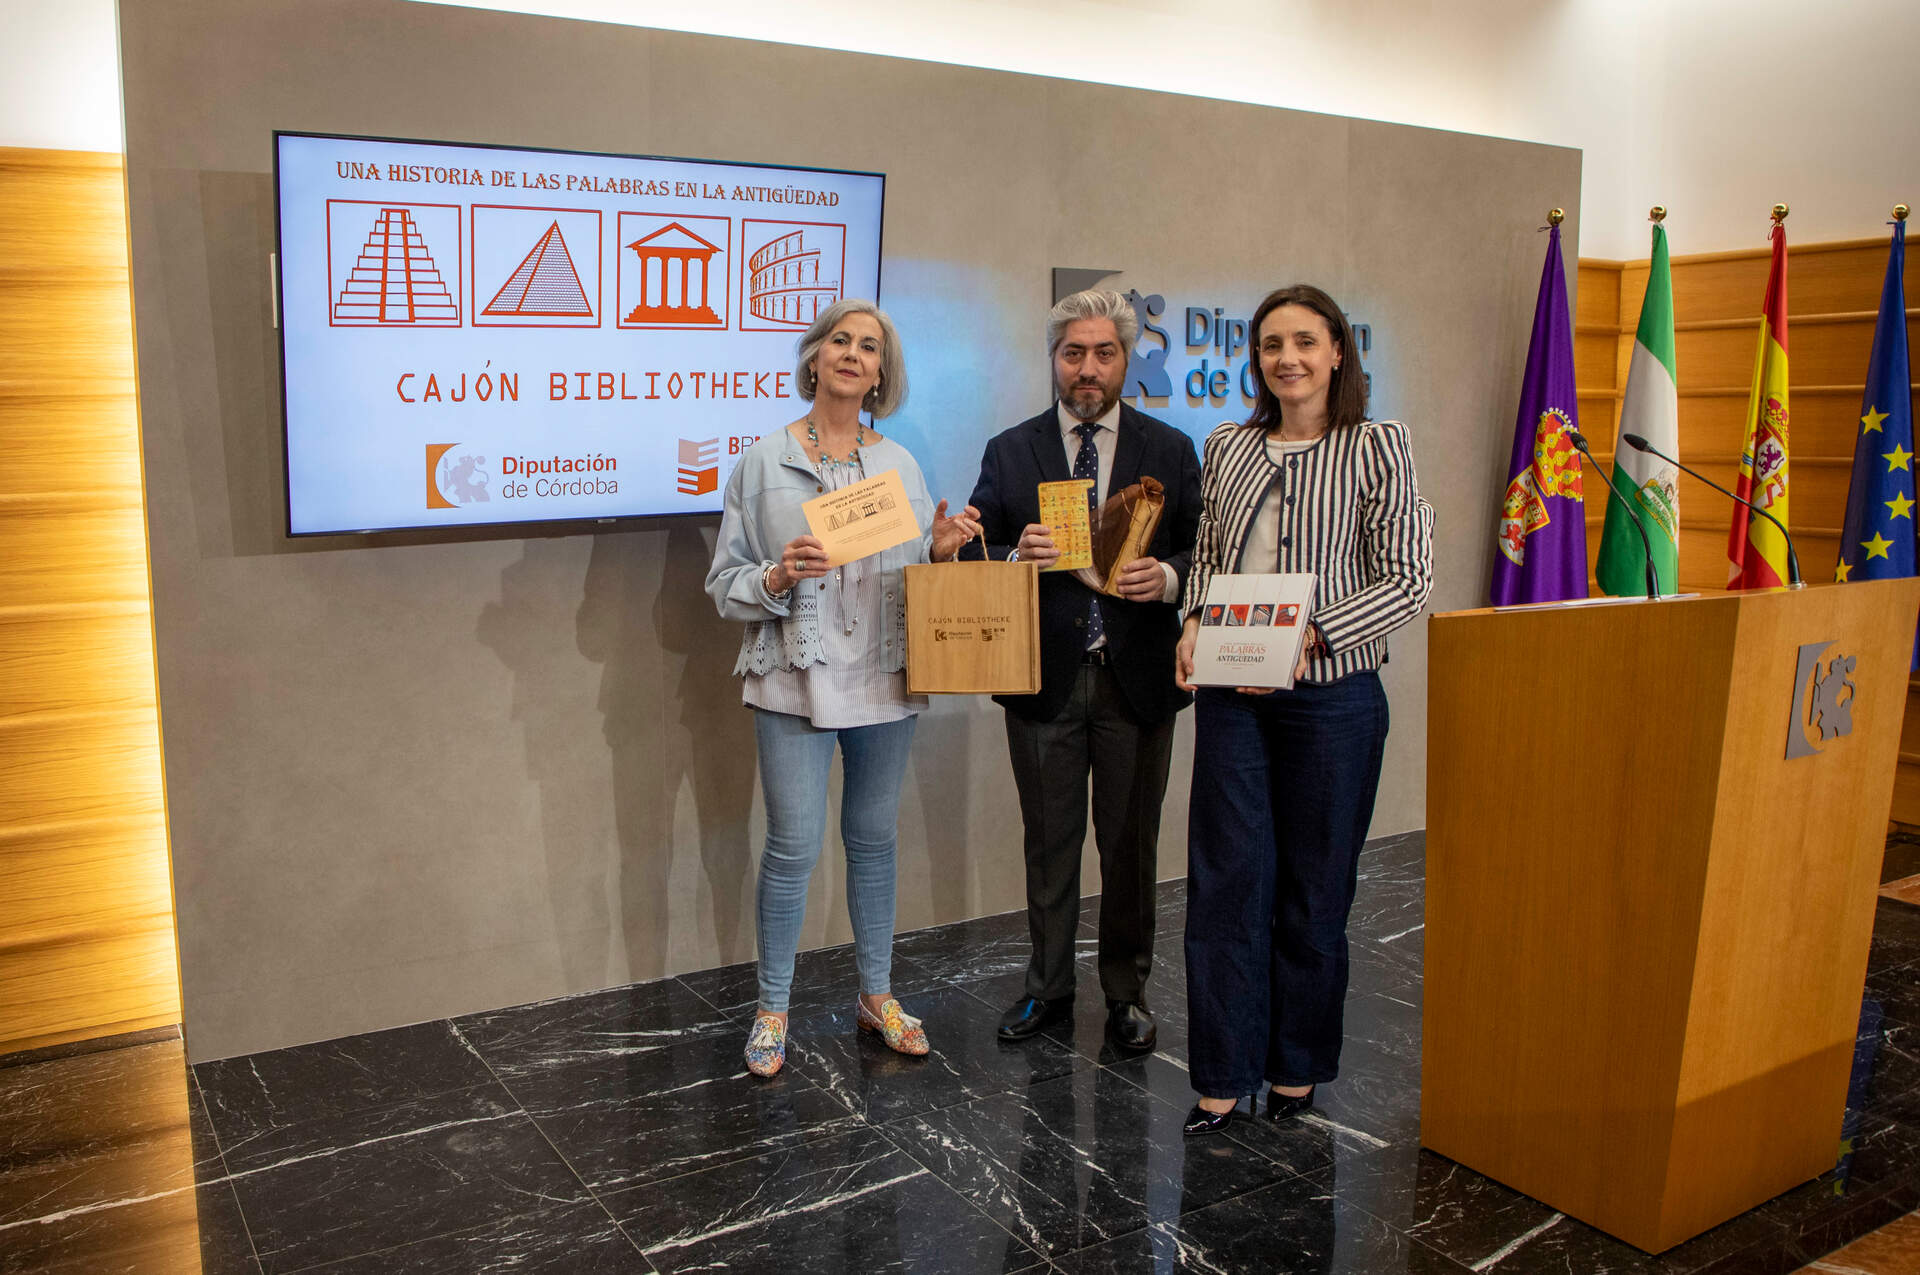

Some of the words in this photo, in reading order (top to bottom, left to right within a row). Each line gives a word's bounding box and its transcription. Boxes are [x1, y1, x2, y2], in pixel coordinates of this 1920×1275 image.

[337, 161, 381, 180] UNA
[388, 164, 484, 186] HISTORIA
[491, 170, 517, 188] DE
[522, 172, 561, 190] LAS
[566, 174, 670, 196] PALABRAS
[675, 181, 697, 198] EN
[703, 183, 726, 201] LA
[731, 184, 840, 207] ANTIGÜEDAD
[397, 360, 519, 402] CAJÓN
[549, 372, 792, 401] BIBLIOTHEKE
[1186, 359, 1230, 398] de
[728, 435, 761, 456] BP
[502, 453, 617, 478] Diputación
[502, 480, 529, 499] de
[535, 476, 619, 498] Córdoba
[1219, 645, 1266, 654] PALABRAS
